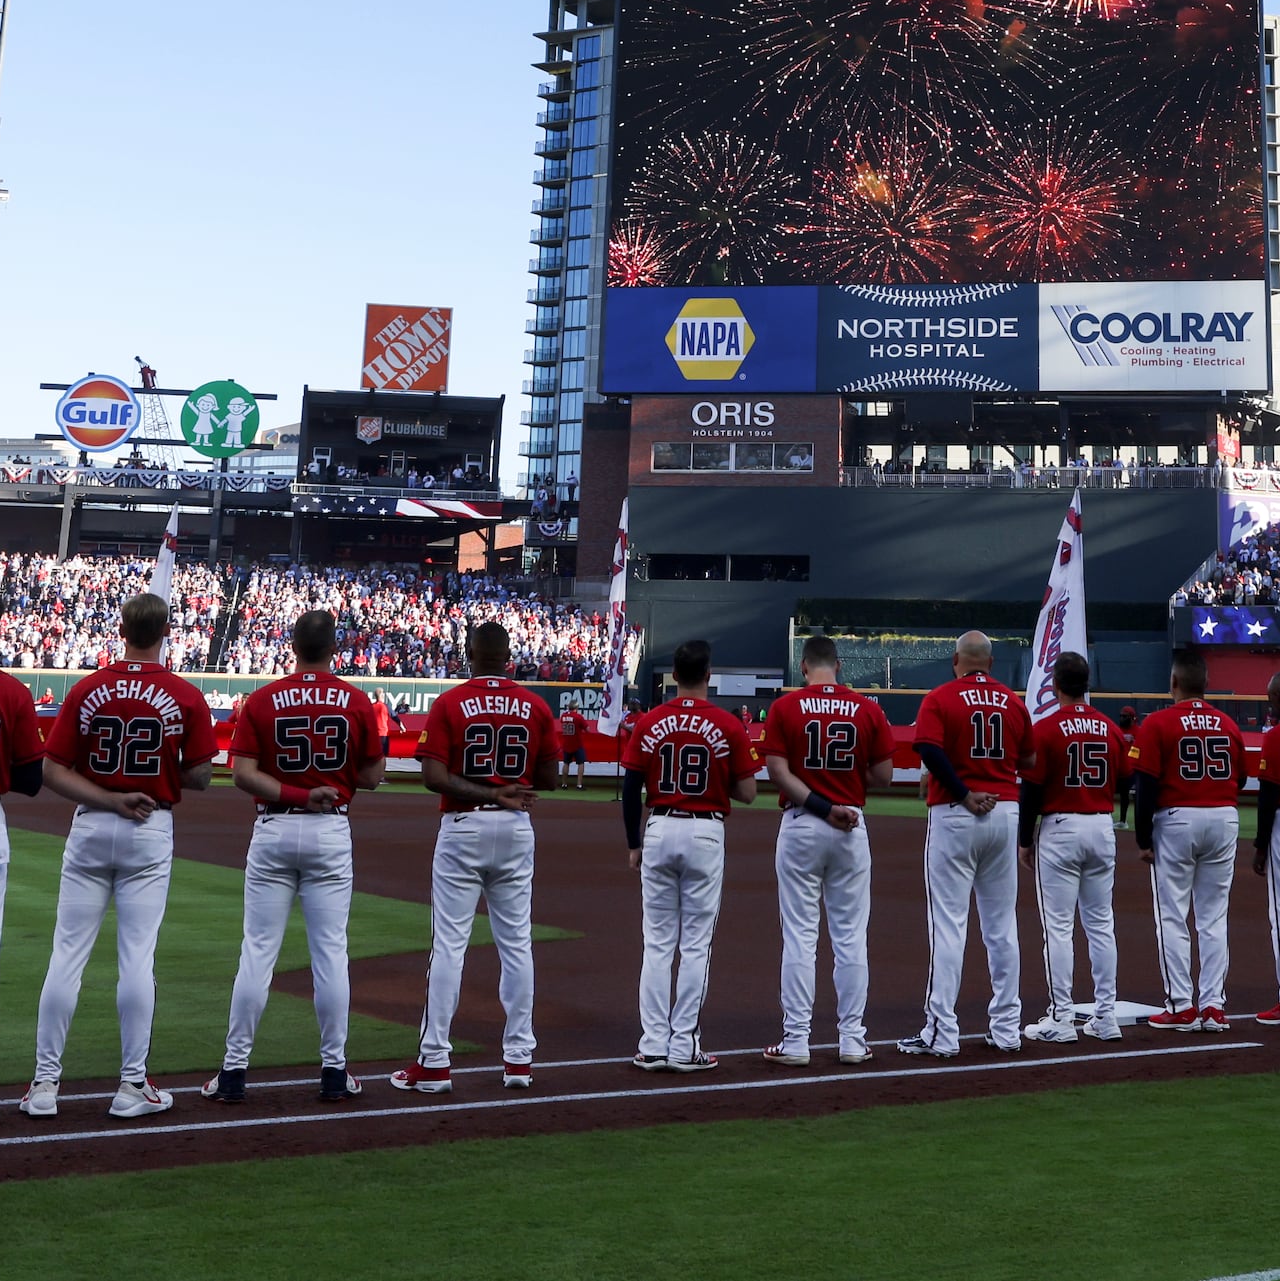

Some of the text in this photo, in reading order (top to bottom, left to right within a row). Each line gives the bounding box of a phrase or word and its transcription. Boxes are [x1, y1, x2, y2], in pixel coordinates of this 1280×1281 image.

[373, 314, 410, 348] THE
[680, 321, 741, 357] NAPA
[837, 317, 1019, 339] NORTHSIDE
[1070, 312, 1255, 344] COOLRAY
[363, 307, 451, 390] HOME
[396, 338, 450, 390] DEPOT
[870, 343, 985, 359] HOSPITAL
[1120, 346, 1216, 356] Cooling Heating
[1131, 357, 1245, 368] Plumbing Electrical
[62, 401, 134, 426] Gulf
[691, 401, 776, 427] ORIS
[384, 422, 446, 438] CLUBHOUSE
[692, 428, 774, 438] HÖLSTEIN 1904
[80, 679, 184, 737] SMITH-SHAWVER
[271, 687, 351, 711] HICKLEN
[459, 695, 532, 720] IGLESIAS
[799, 697, 861, 718] MURPHY
[959, 689, 1009, 710] TELLEZ
[640, 713, 730, 759] YASTRZEMSKI
[970, 710, 1005, 760] 11
[1058, 717, 1108, 738] FARMER
[1180, 711, 1222, 732] PÉREZ
[89, 715, 164, 776] 32
[274, 715, 349, 773] 53
[463, 723, 529, 779] 26
[804, 720, 858, 771] 12
[1178, 736, 1232, 781] 95
[658, 742, 711, 796] 18
[1064, 741, 1108, 788] 15
